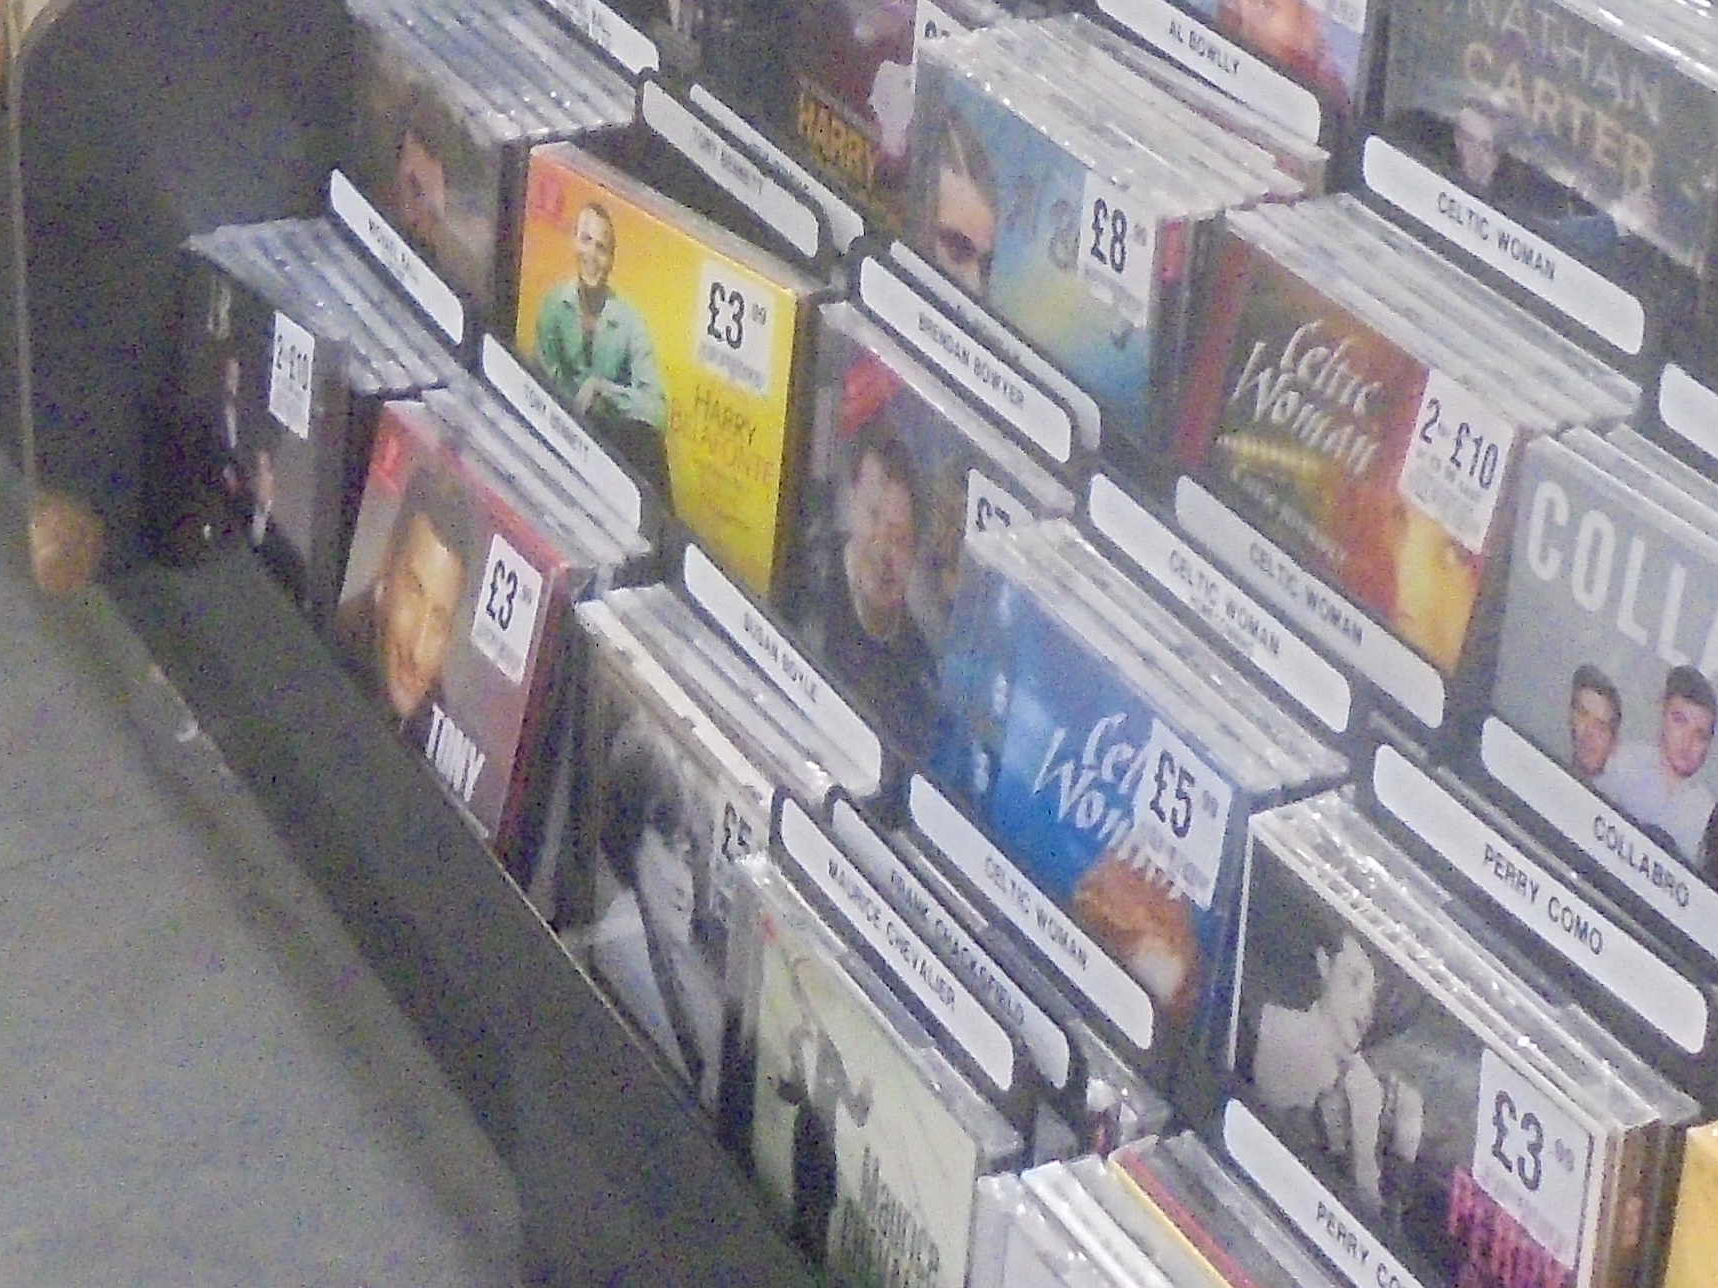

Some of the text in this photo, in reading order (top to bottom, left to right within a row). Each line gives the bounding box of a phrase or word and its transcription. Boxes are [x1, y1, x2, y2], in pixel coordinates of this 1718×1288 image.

[1168, 22, 1240, 76] AL BOWLLY
[1436, 190, 1557, 282] CELTIC WOMAN
[1168, 547, 1280, 656] CELTIC WOMAN
[1248, 541, 1364, 646] CELTIC WOMAN
[984, 855, 1088, 972] CELTIC WOMAN
[1484, 843, 1604, 956] PERRY COMO
[1592, 815, 1690, 909] COLLABRO
[827, 858, 956, 1010] MAURICE CHEVALIER
[1315, 1202, 1370, 1267] PERRY
